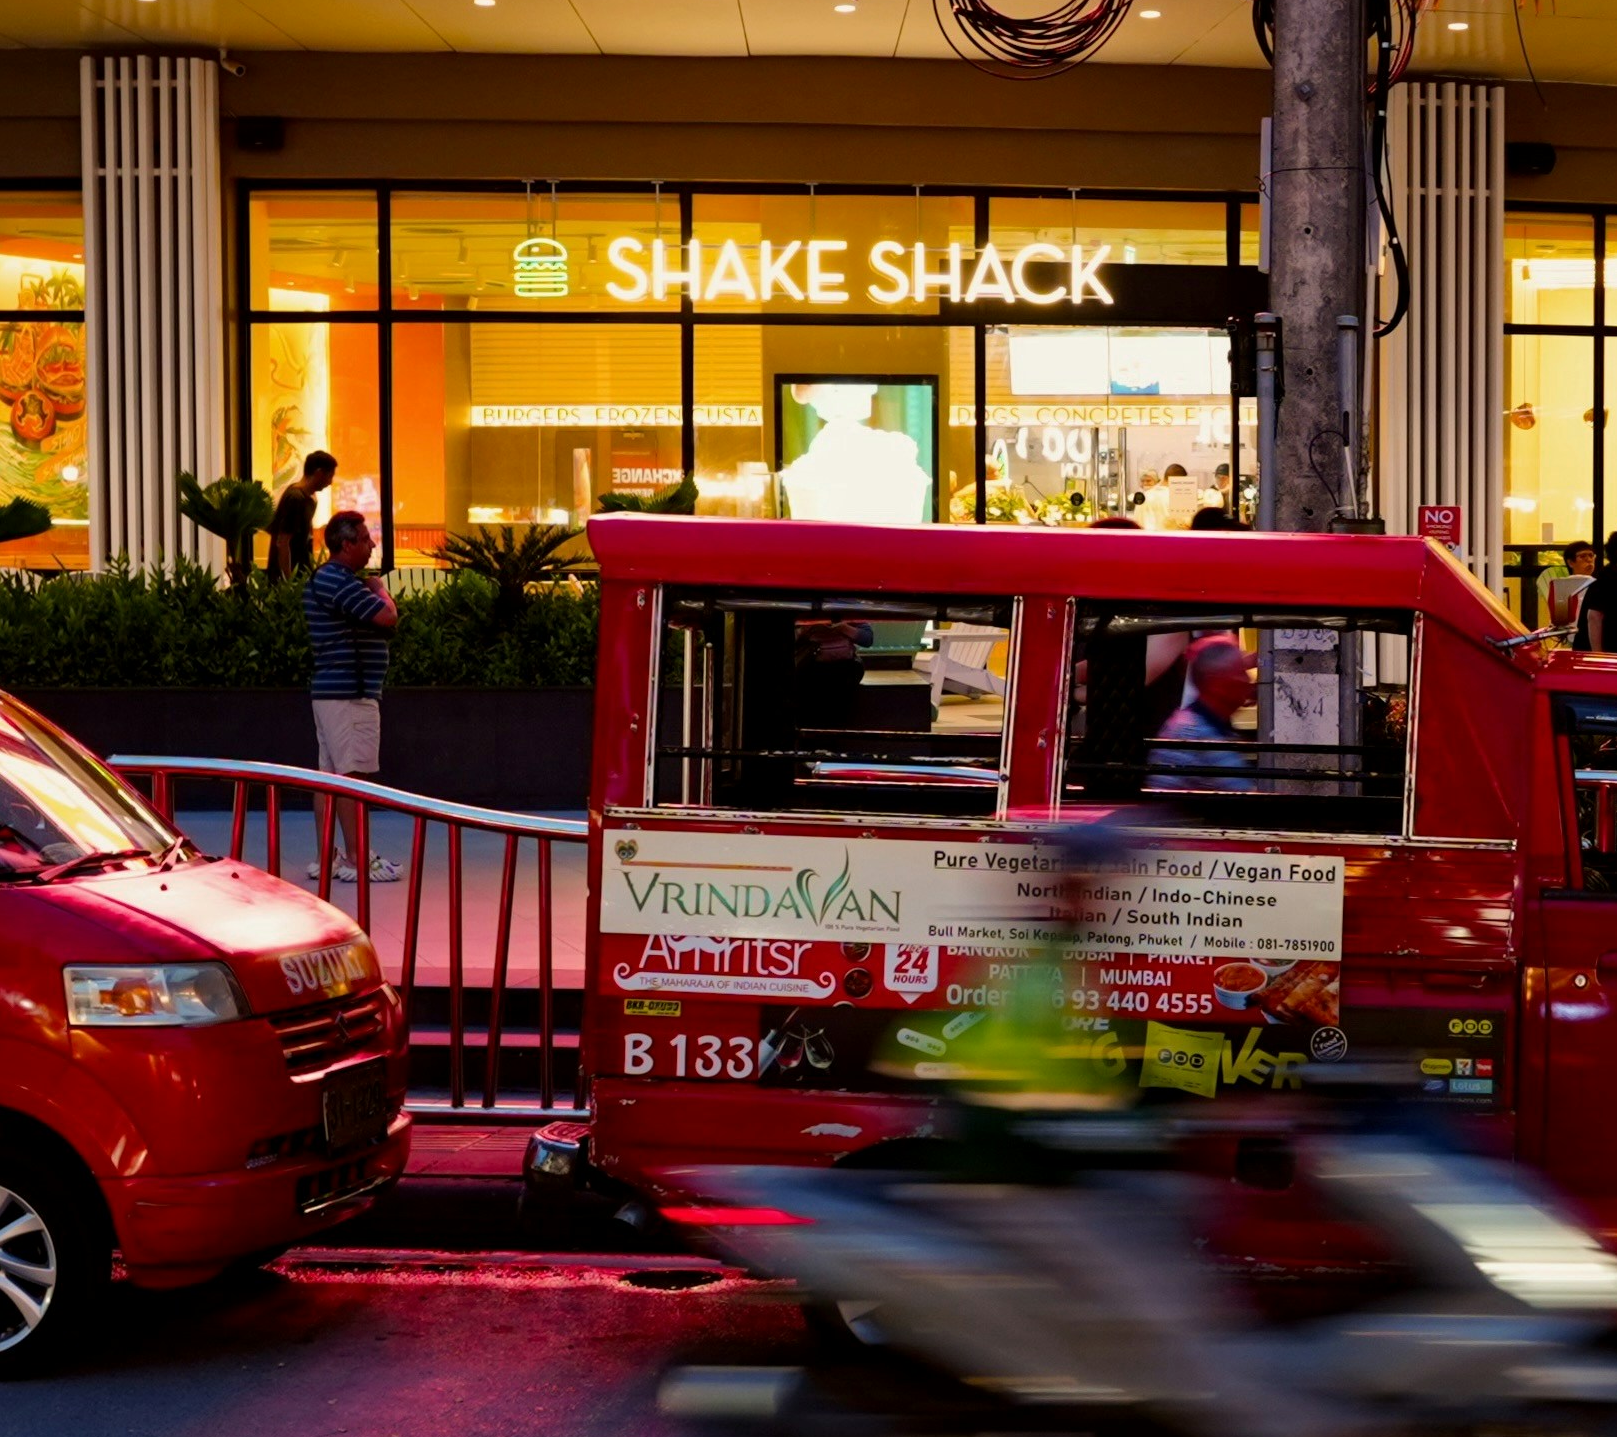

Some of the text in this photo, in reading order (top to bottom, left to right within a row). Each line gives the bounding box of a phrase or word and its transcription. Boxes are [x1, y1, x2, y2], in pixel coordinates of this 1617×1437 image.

[605, 236, 1115, 305] SHAKE SHACK
[484, 407, 581, 425] BURGERS
[595, 407, 681, 425] FROZEN
[692, 407, 759, 425] CUSTA
[1036, 407, 1173, 426] CONCRETES
[1424, 510, 1454, 524] NO
[934, 850, 978, 868] Pure
[985, 853, 1083, 874] Vegetar
[1155, 859, 1202, 877] Food
[1224, 860, 1282, 884] Vegan
[1289, 864, 1336, 882] Food
[611, 845, 902, 927] VRINDAVAN
[1151, 888, 1277, 907] Indo-Chinese
[1127, 908, 1180, 926] South
[1186, 912, 1243, 929] Indian
[928, 925, 954, 937] Bull
[957, 927, 1004, 941] Market,
[1009, 928, 1031, 941] Soi
[1087, 931, 1134, 947] Patong,
[1137, 932, 1183, 947] Phuket
[1203, 935, 1244, 949] Mobile
[1256, 937, 1335, 952] 081-7851900
[279, 945, 368, 996] SUZUKI
[893, 947, 928, 974] 24
[639, 976, 810, 993] THE MAHARAJA OF INDIAN CUISINE
[893, 974, 928, 984] HOURS
[1099, 967, 1172, 986] MUMBAI
[945, 986, 1008, 1006] Order
[1071, 993, 1099, 1014] 93
[1105, 994, 1149, 1016] 440
[1155, 996, 1213, 1018] 4555
[624, 1033, 754, 1079] B 133
